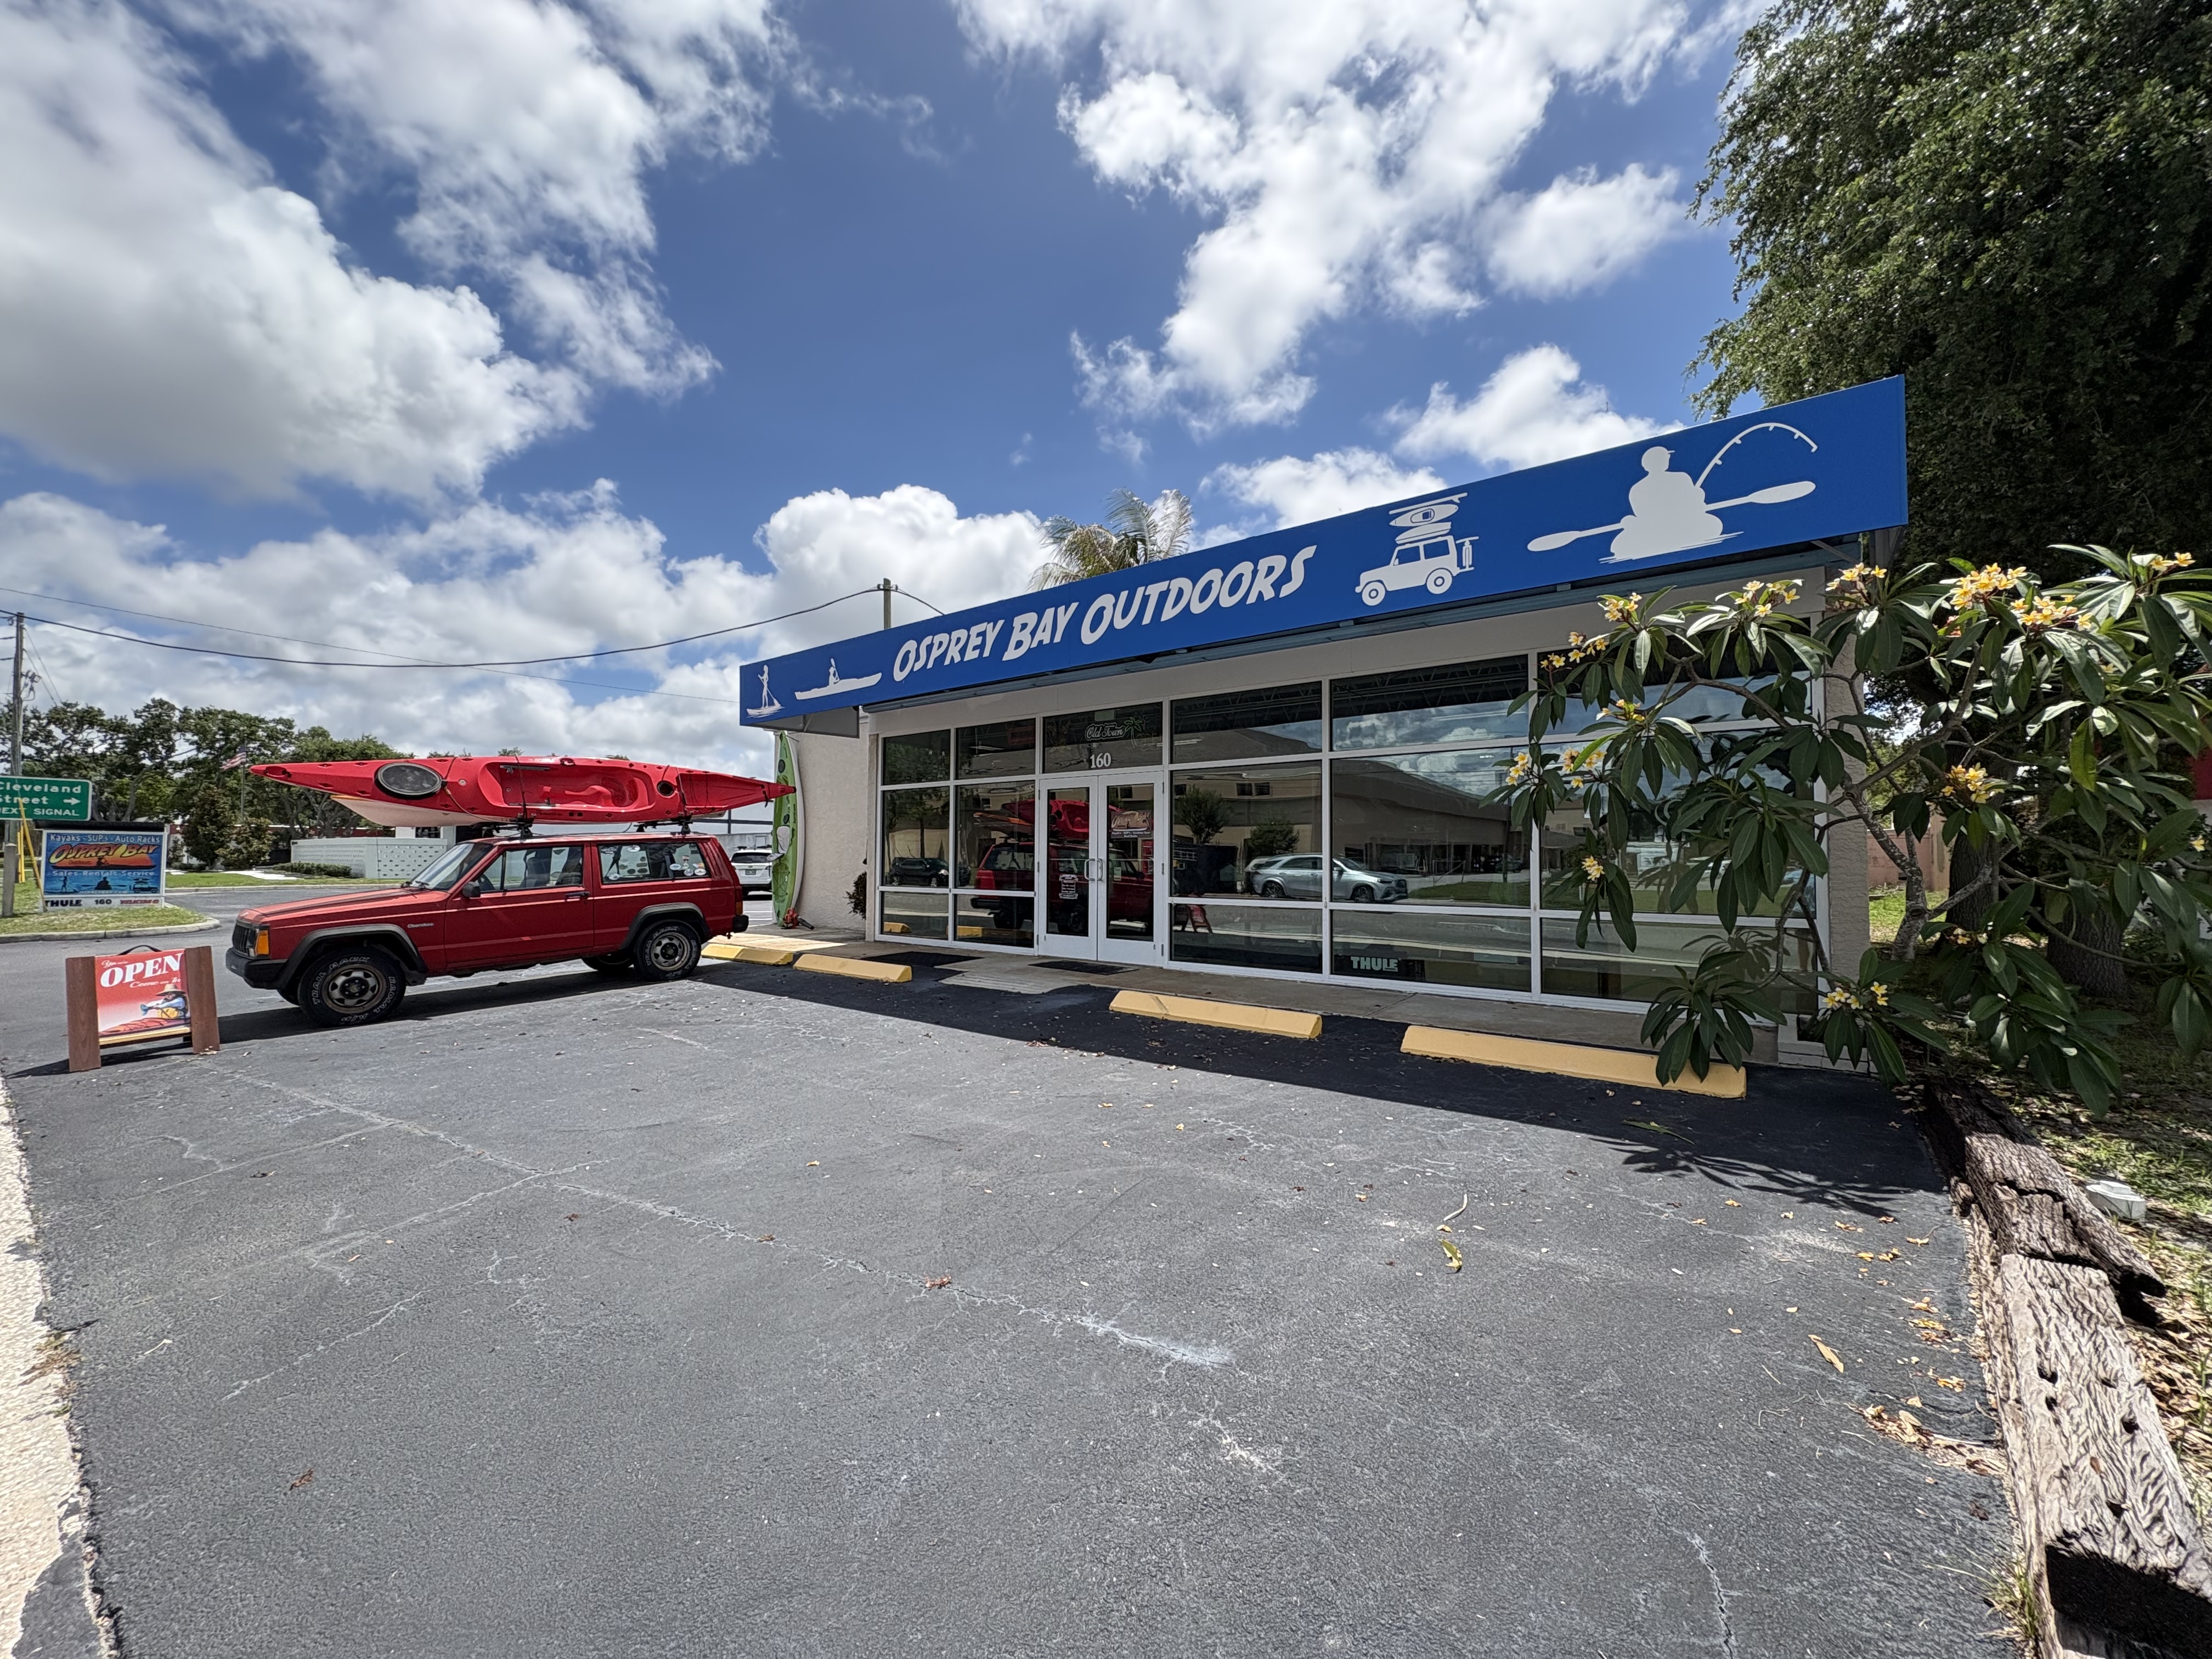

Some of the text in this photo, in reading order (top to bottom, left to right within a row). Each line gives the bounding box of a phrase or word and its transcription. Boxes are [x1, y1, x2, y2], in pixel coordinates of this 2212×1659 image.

[893, 545, 1317, 682] OSPREY BAY OUTDOORS
[1086, 725, 1124, 739] Old Town
[1090, 752, 1111, 769] 160
[33, 808, 80, 816] SIGNAL
[50, 833, 80, 843] Kayaks
[49, 844, 159, 864] OSPREY BAY
[100, 952, 184, 988] OPEN
[1351, 956, 1398, 972] THULE
